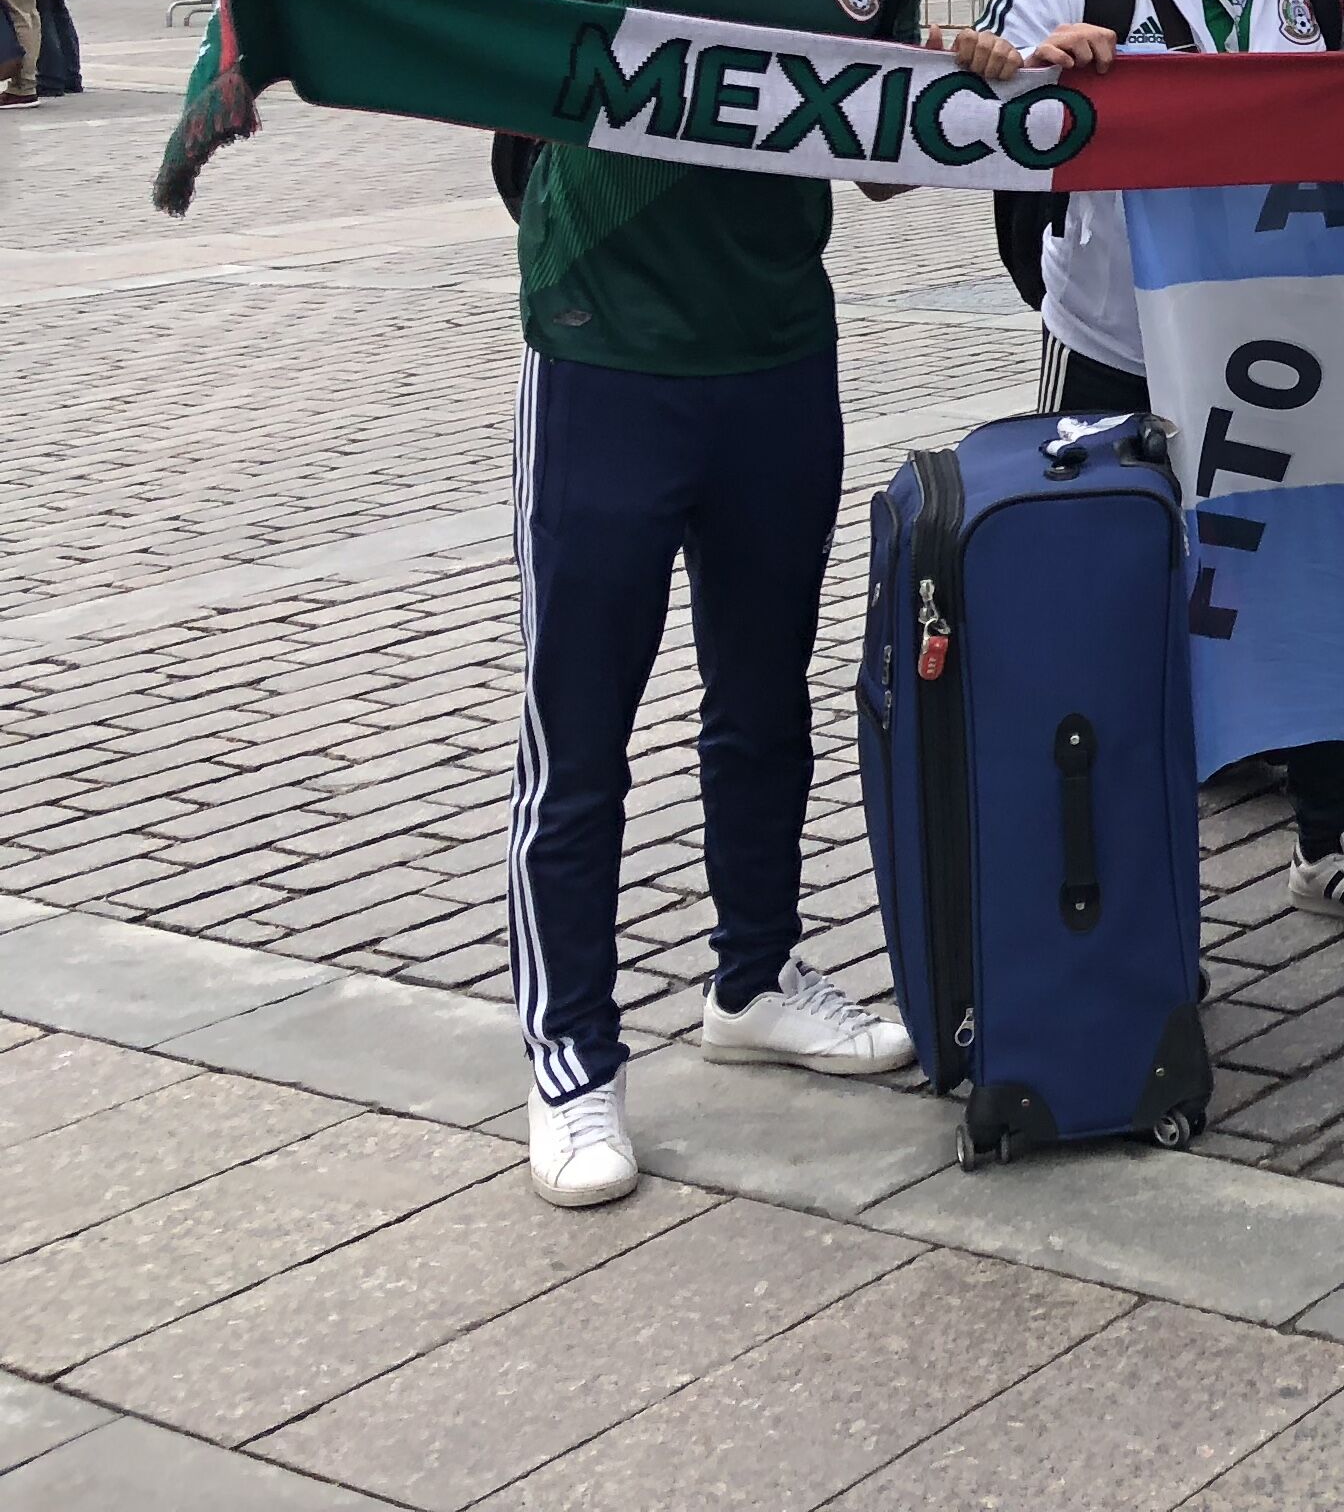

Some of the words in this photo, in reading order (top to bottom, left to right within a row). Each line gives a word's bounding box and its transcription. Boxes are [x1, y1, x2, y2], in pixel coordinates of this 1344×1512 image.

[552, 22, 1097, 170] MEXICO
[1128, 32, 1166, 44] adida
[1189, 339, 1323, 641] FITO
